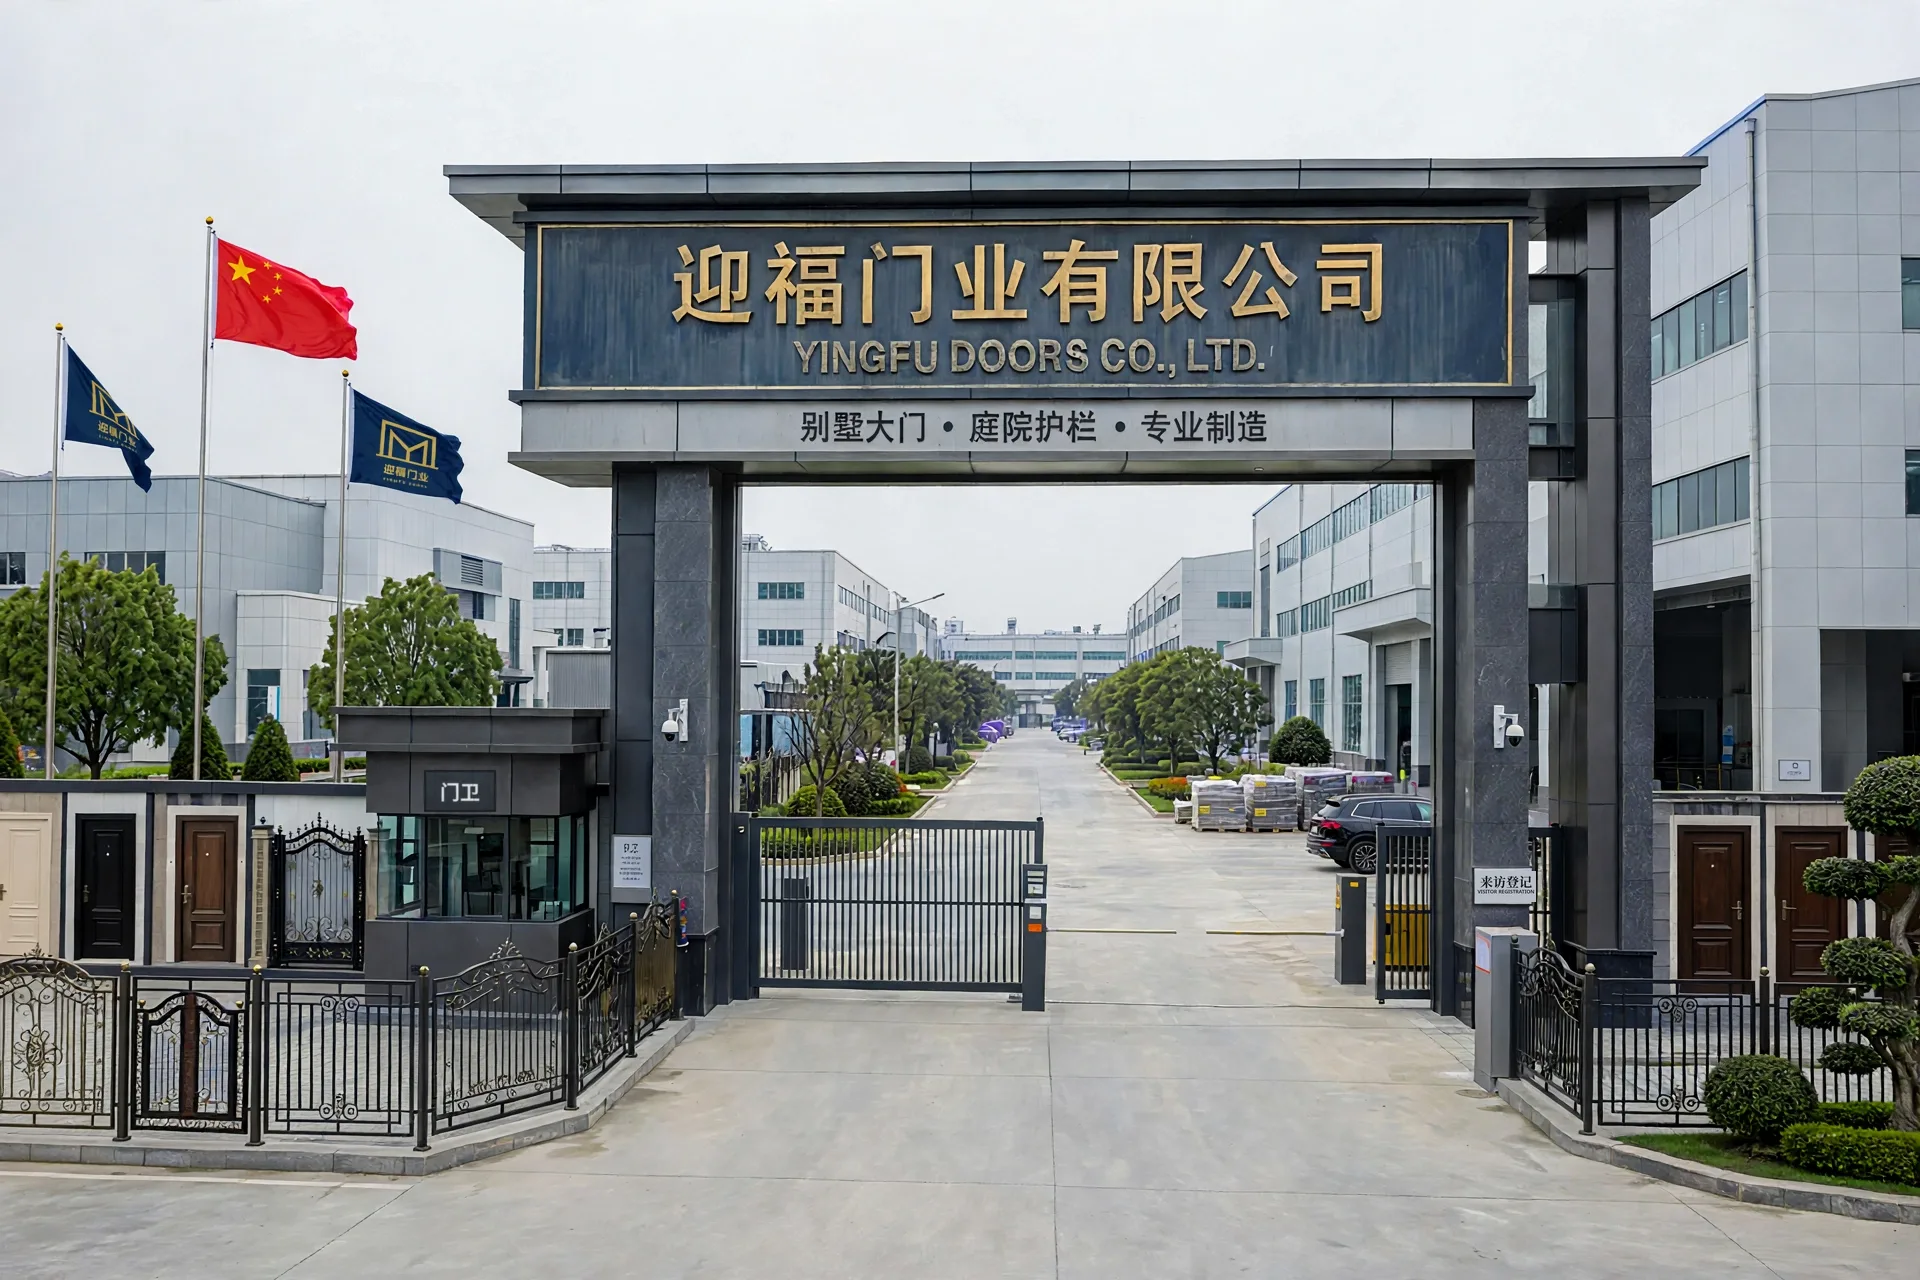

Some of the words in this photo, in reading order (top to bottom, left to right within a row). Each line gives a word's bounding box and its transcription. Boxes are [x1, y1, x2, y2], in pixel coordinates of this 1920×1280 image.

[672, 239, 1382, 324] 迎福门业有限公司
[793, 340, 938, 374] YINGFU
[951, 339, 1089, 373] DOORS
[1101, 338, 1176, 378] CO.,
[1187, 338, 1265, 372] LTD.
[800, 411, 925, 443] 别墅大门
[969, 410, 1097, 443] 庭院护栏
[1141, 410, 1267, 444] 专业制造
[441, 782, 480, 802] 门卫
[1480, 876, 1532, 888] 来访登记
